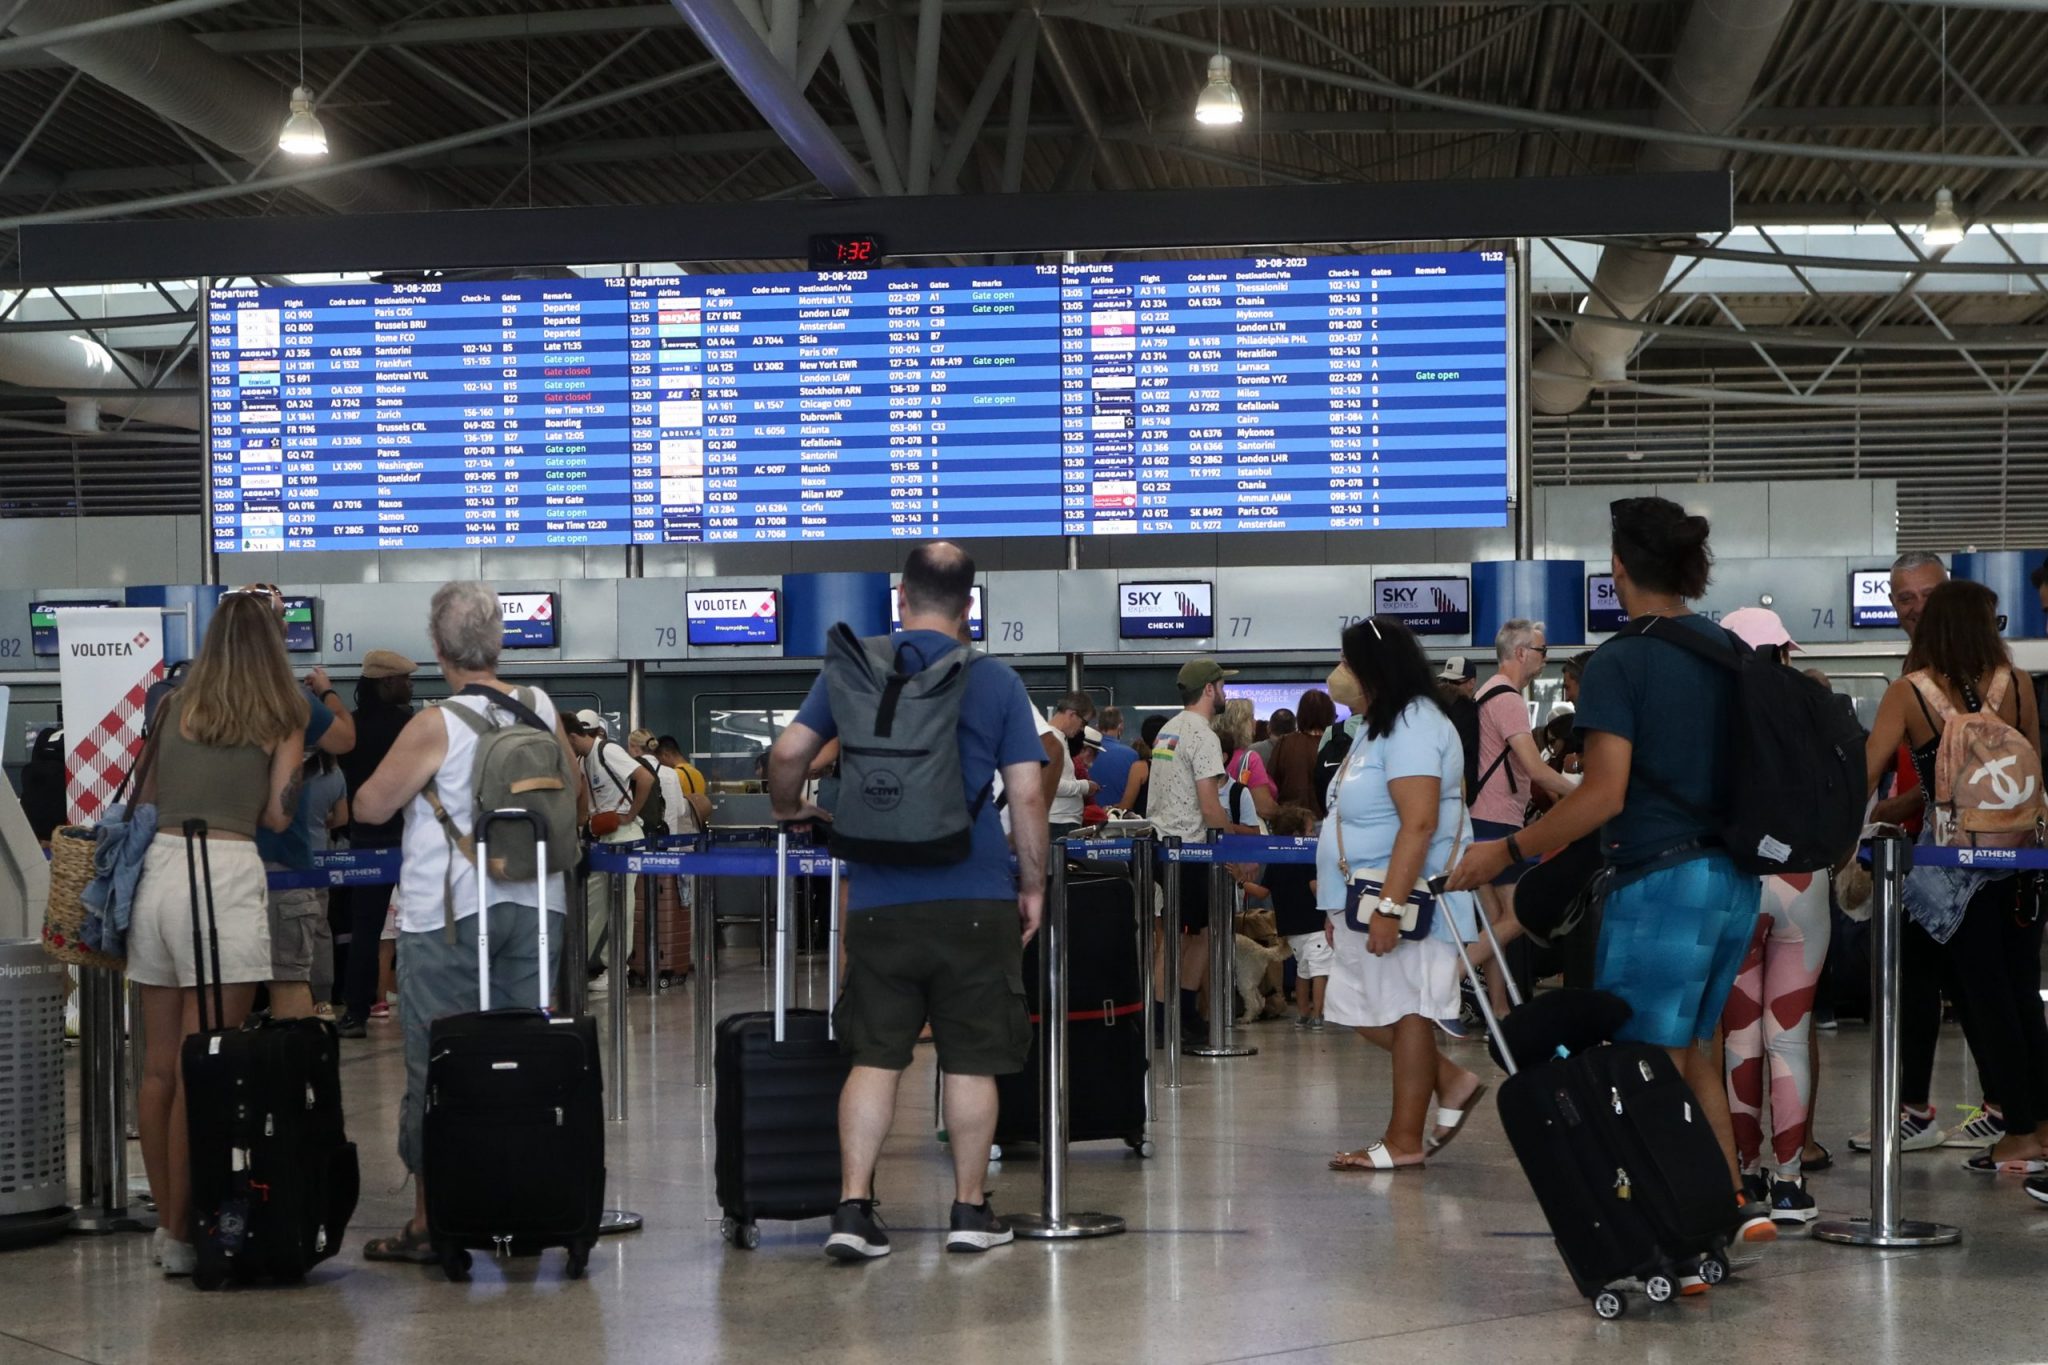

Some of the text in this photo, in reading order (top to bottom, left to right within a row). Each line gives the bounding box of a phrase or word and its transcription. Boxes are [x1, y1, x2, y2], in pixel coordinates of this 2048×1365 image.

[1480, 251, 1504, 262] 11:32
[1256, 257, 1307, 268] 30-08-2023
[1036, 264, 1056, 274] 11:32
[1061, 263, 1114, 274] Departures
[818, 270, 868, 281] 30-08-2023
[1140, 274, 1160, 283] Flight
[604, 278, 626, 287] 11:32
[629, 276, 680, 287] Departures
[393, 283, 441, 293] 30-08-2023
[706, 288, 725, 296] Flight
[210, 289, 259, 300] Departures
[461, 294, 491, 302] Check-in
[284, 300, 303, 308] Flight
[1236, 297, 1265, 305] Chania
[800, 308, 849, 317] London LGW
[930, 306, 945, 314] C35
[972, 304, 1014, 314] Gate open
[544, 316, 580, 326] Departed
[631, 314, 649, 322] 12:15
[212, 325, 230, 333] 10:45
[376, 320, 426, 329] Brussels BRU
[1237, 322, 1268, 331] London
[1063, 326, 1082, 335] 13:10
[463, 344, 491, 352] 102-143
[544, 341, 582, 350] Late 11:35
[212, 350, 230, 359] 11:10
[375, 346, 411, 355] Santorini
[800, 360, 857, 369] New York EWR
[376, 371, 428, 380] Montreal YUL
[503, 369, 517, 377] C32
[544, 368, 563, 376] Gate
[1416, 372, 1459, 381] Gate open
[1237, 375, 1270, 384] Toronto
[666, 390, 684, 398] SAS
[800, 386, 861, 395] Stockholm ARN
[376, 397, 403, 406] Samos
[801, 412, 841, 420] Dubrovnik
[377, 422, 425, 431] Brussels CRL
[545, 419, 581, 429] Boarding
[1237, 428, 1275, 438] Mykonos
[247, 438, 264, 447] SAS
[377, 448, 400, 457] Paros
[1238, 454, 1288, 462] London LHR
[801, 464, 831, 472] Munich
[1237, 480, 1267, 489] Chania
[802, 490, 824, 498] Milan
[547, 495, 584, 504] New Gate
[1238, 506, 1278, 515] Paris CDG
[379, 524, 418, 533] Rome FCO
[547, 520, 606, 530] New Time 12:20
[1382, 588, 1418, 602] SKY
[1597, 584, 1616, 598] SK
[1128, 592, 1162, 605] SKY
[1128, 605, 1162, 613] express
[1403, 618, 1430, 626] CHECK
[1811, 608, 1835, 628] 74
[1001, 621, 1024, 642] 78
[1230, 617, 1252, 637] 77
[655, 627, 677, 648] 79
[333, 633, 352, 652] 81
[0, 638, 21, 658] 82
[1974, 850, 2017, 858] ATHENS
[642, 857, 680, 865] ATHENS
[344, 868, 381, 877] ATHENS
